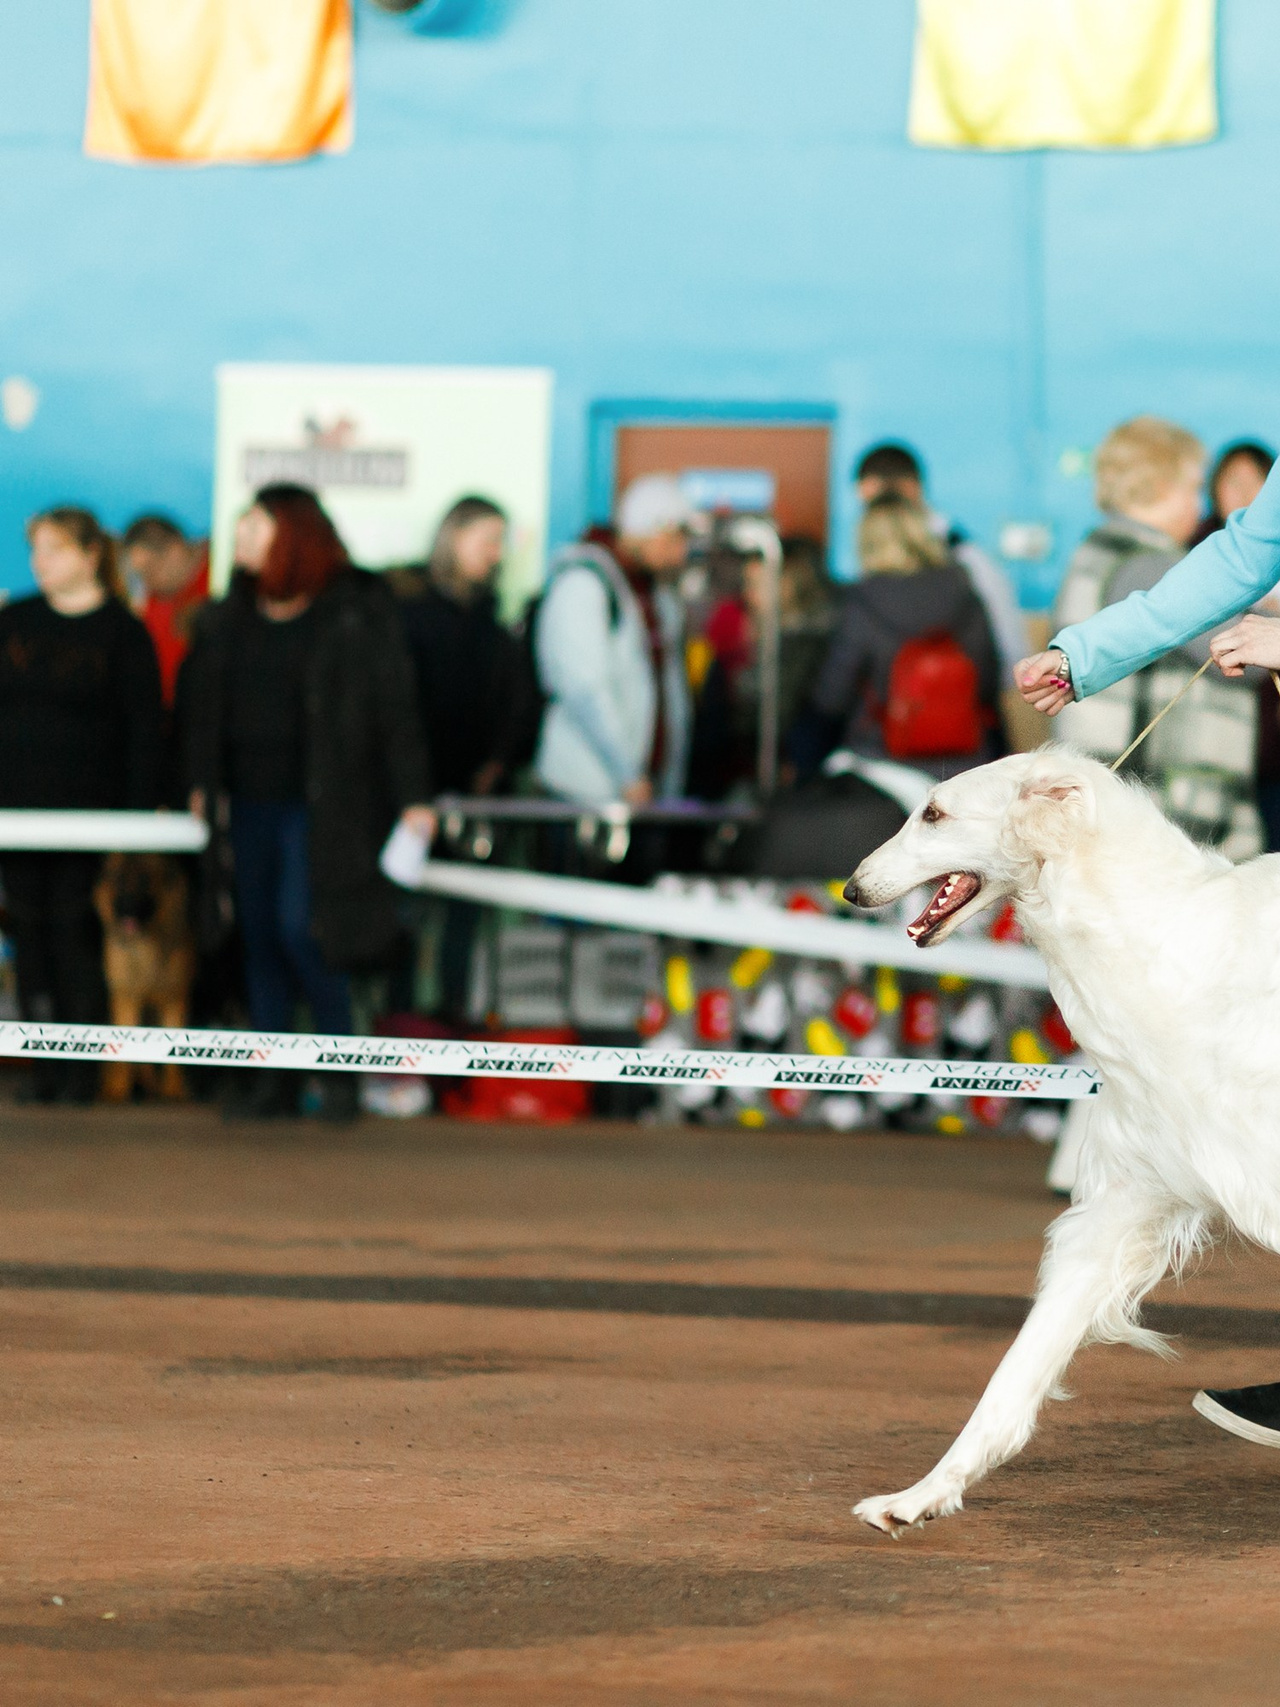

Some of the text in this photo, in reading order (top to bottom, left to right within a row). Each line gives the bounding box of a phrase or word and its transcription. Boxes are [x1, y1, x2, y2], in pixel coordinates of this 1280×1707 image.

[623, 1065, 706, 1078] PURINA
[778, 1072, 862, 1084] PURINA
[934, 1077, 1019, 1090] PURINA
